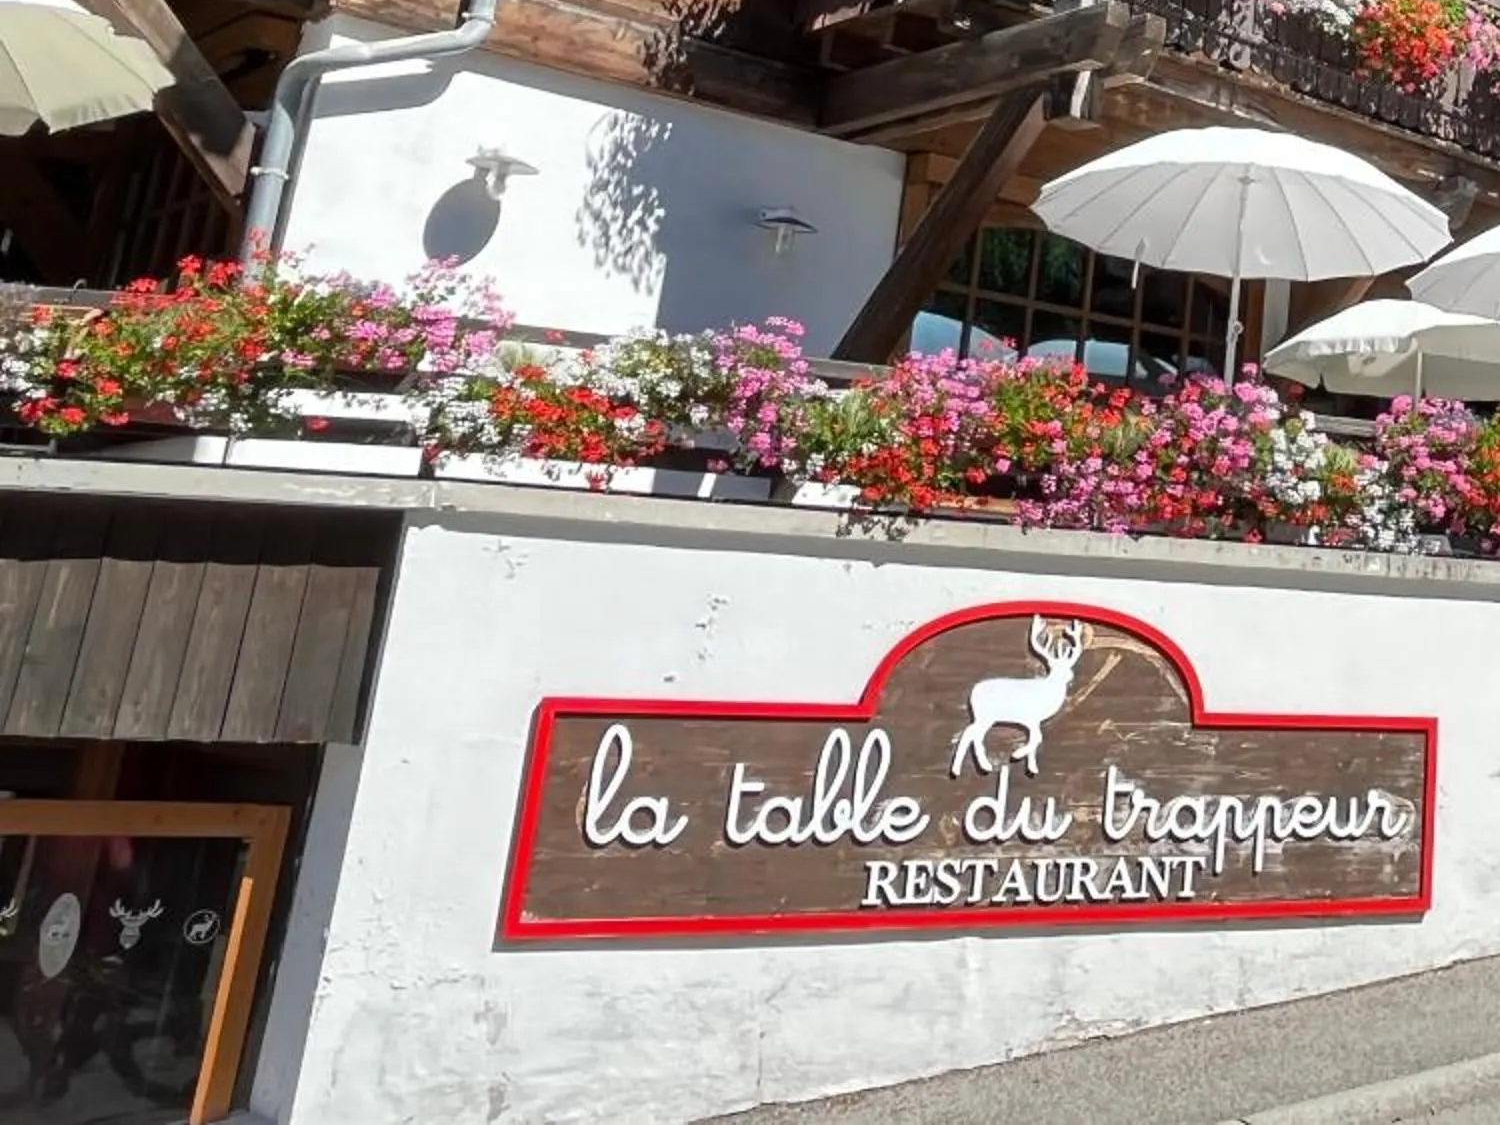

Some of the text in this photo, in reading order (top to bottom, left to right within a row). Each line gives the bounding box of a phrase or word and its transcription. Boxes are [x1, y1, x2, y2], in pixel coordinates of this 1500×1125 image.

[585, 724, 1409, 874] la table du trappeur
[861, 854, 1206, 906] RESTAURANT
